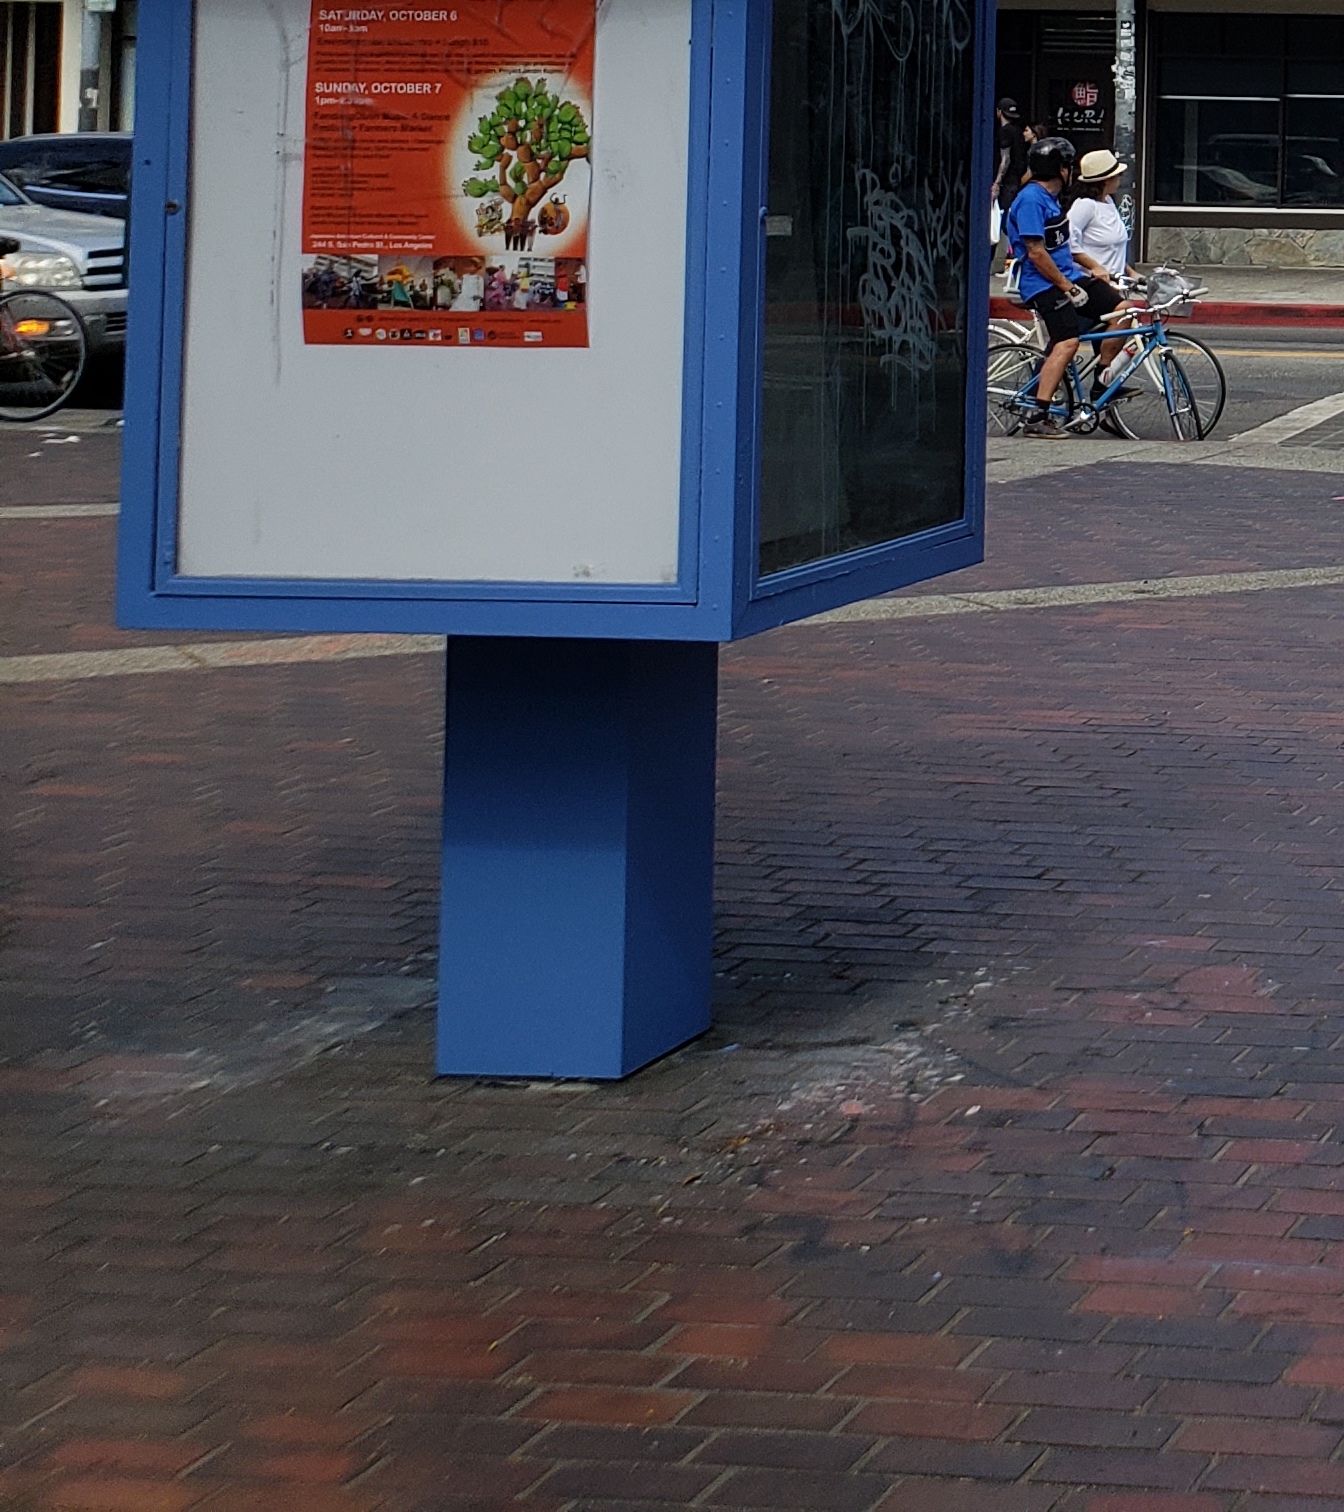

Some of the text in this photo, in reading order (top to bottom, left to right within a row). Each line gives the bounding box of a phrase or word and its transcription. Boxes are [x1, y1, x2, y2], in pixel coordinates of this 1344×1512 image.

[389, 10, 448, 22] OCTOBER
[315, 82, 442, 95] SUNDAY, OCTOBER 7
